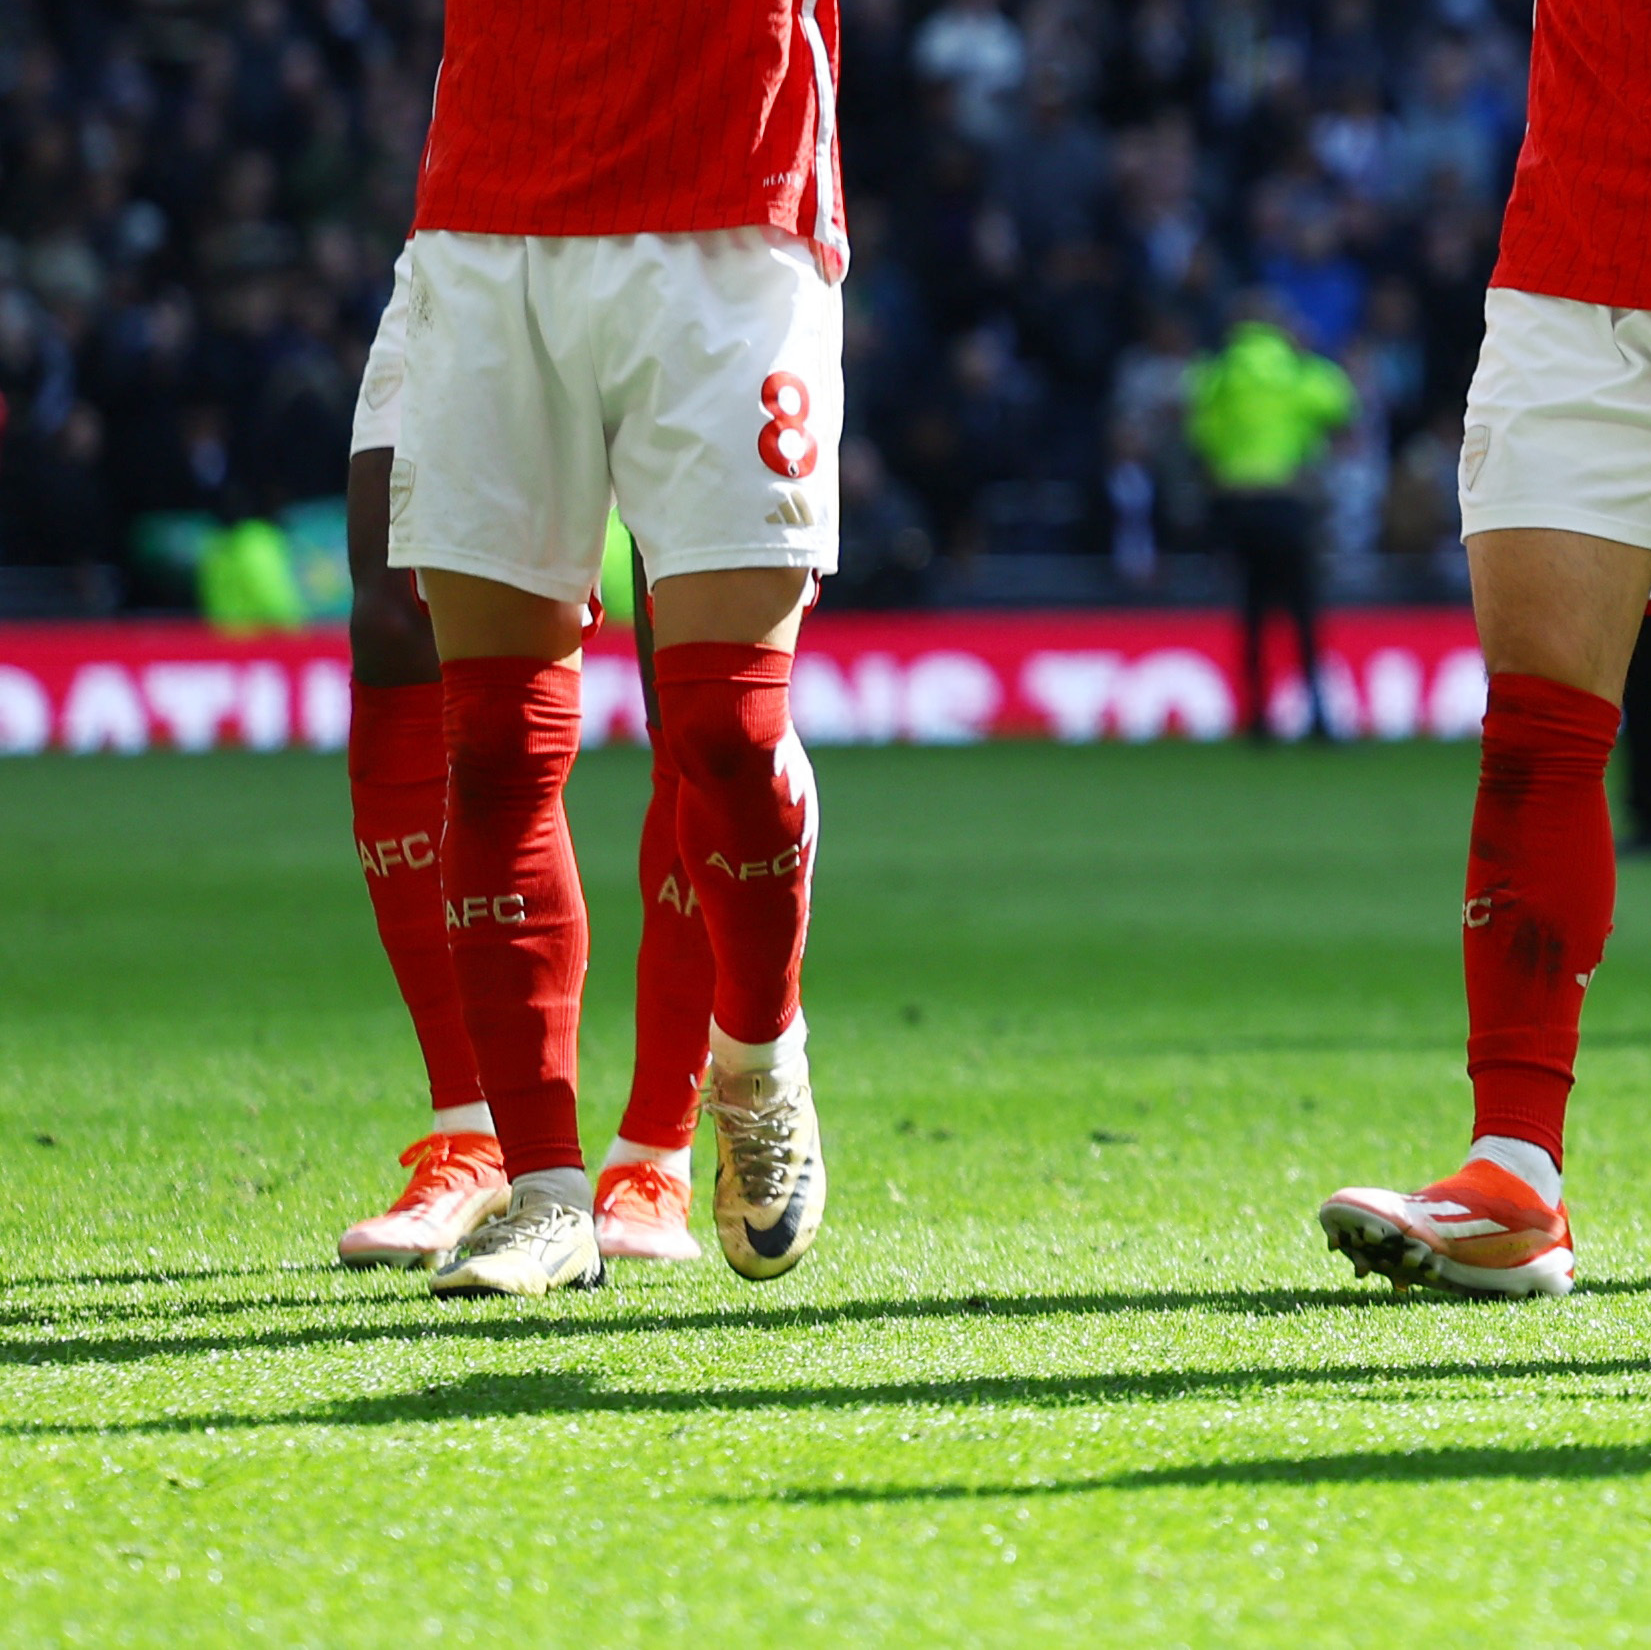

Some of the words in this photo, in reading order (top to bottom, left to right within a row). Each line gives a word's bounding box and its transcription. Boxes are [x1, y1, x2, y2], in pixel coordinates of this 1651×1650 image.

[757, 370, 819, 479] 8
[359, 830, 435, 878] AFC
[706, 843, 801, 881] AFC
[446, 893, 526, 933] AFC
